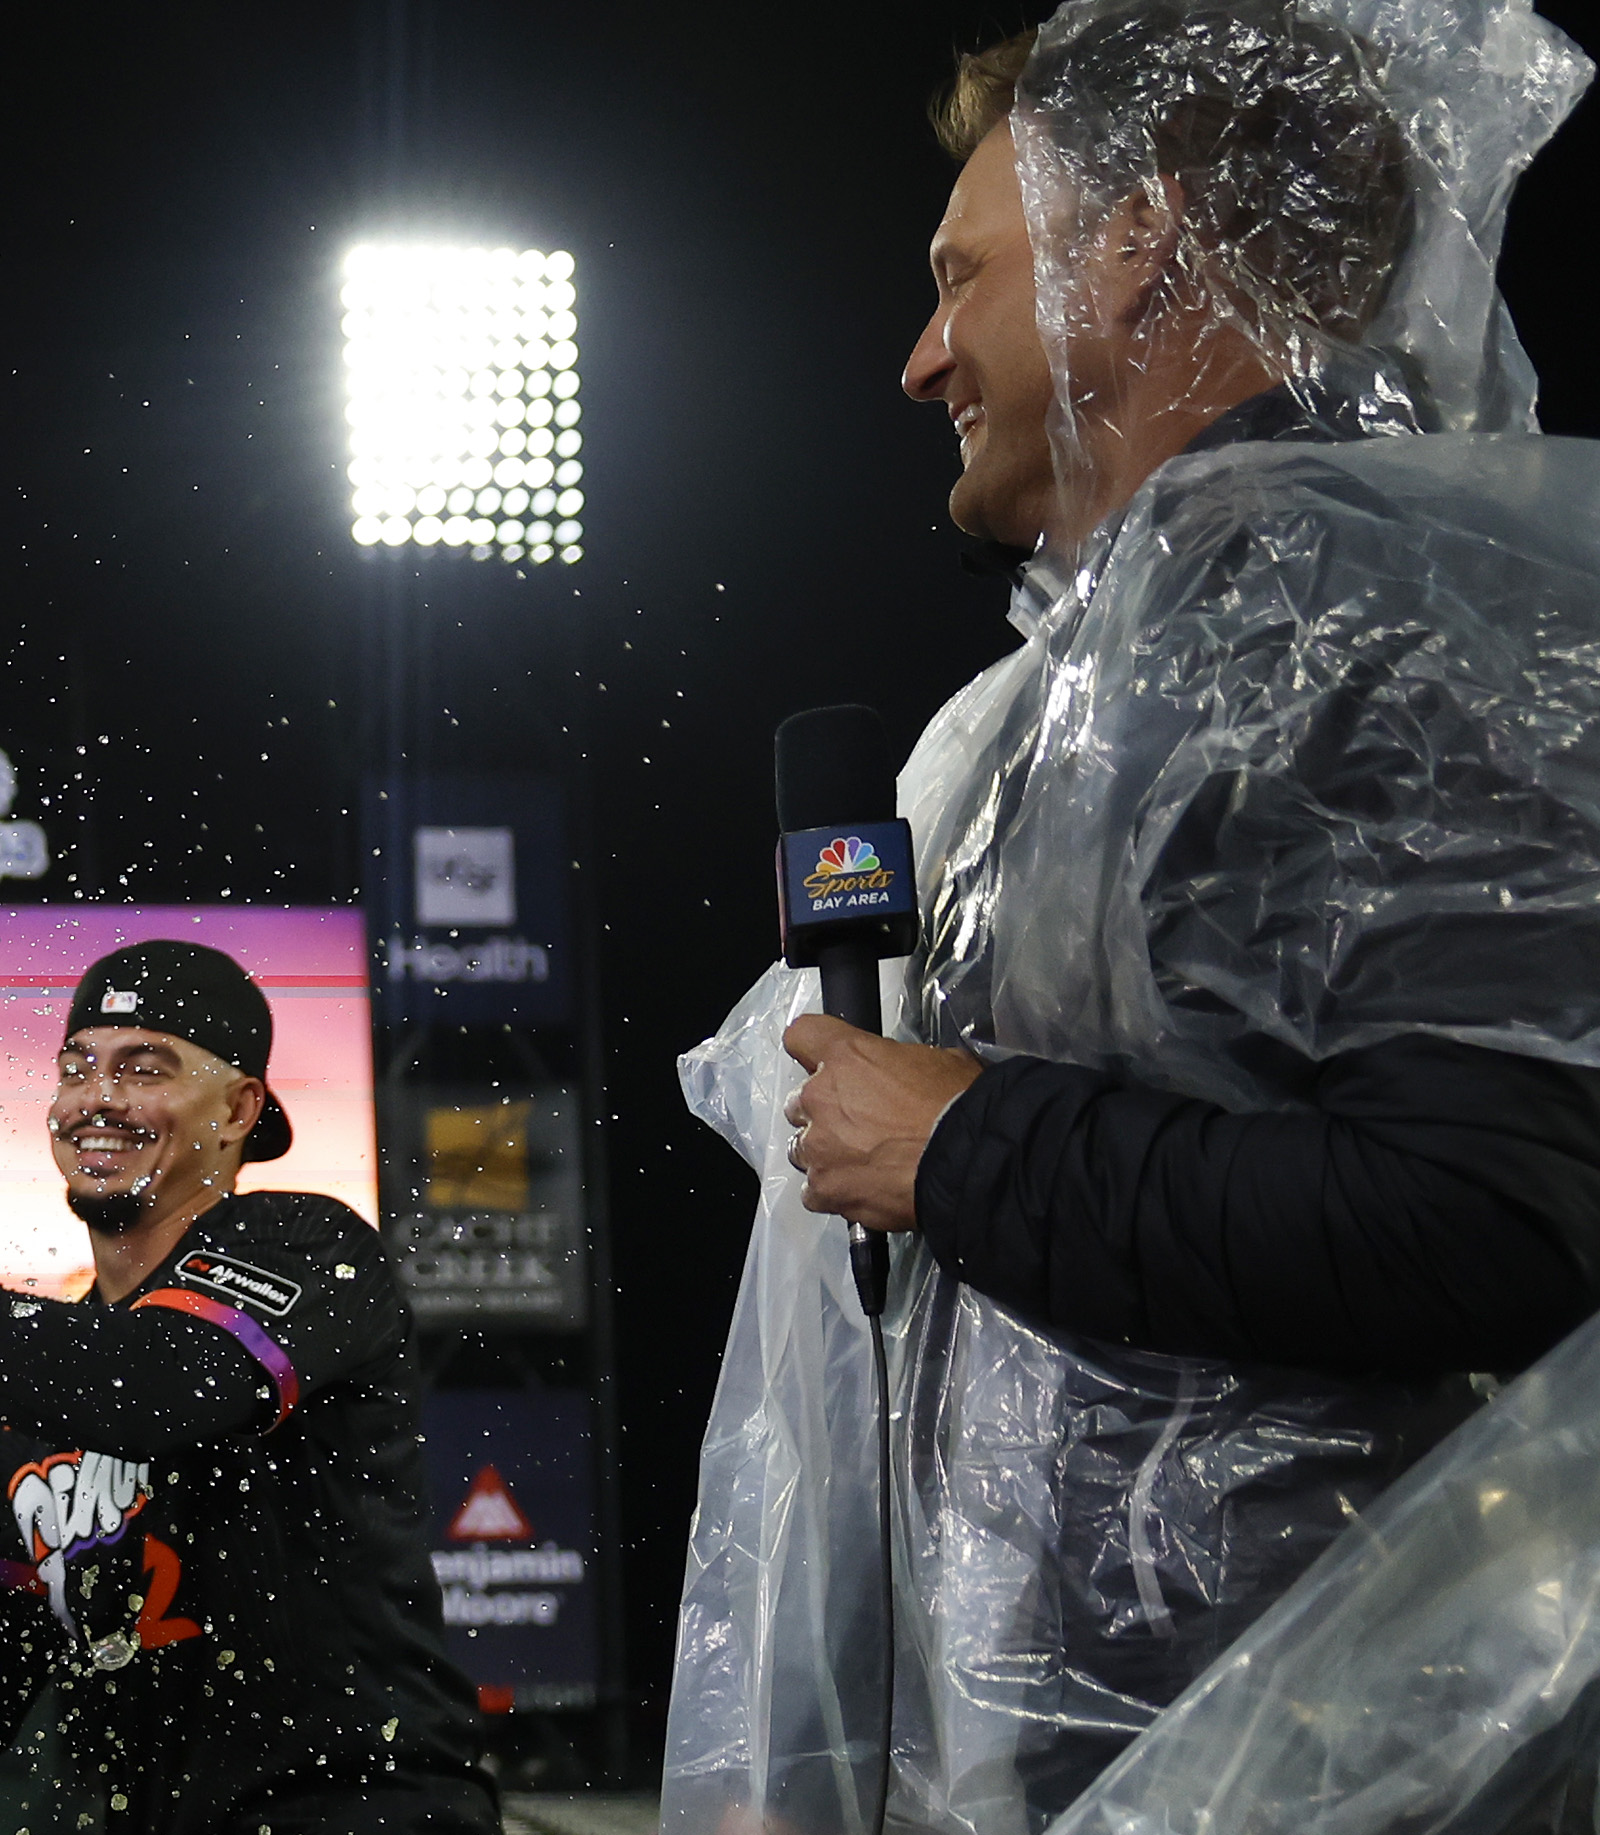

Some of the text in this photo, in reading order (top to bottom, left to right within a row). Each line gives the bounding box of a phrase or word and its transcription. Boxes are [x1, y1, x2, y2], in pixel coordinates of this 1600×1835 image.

[803, 869, 895, 899] Sports
[812, 891, 889, 911] BAY AREA
[388, 934, 549, 982] Health
[208, 1264, 290, 1305] Airwallex
[430, 1541, 585, 1589] enjamin
